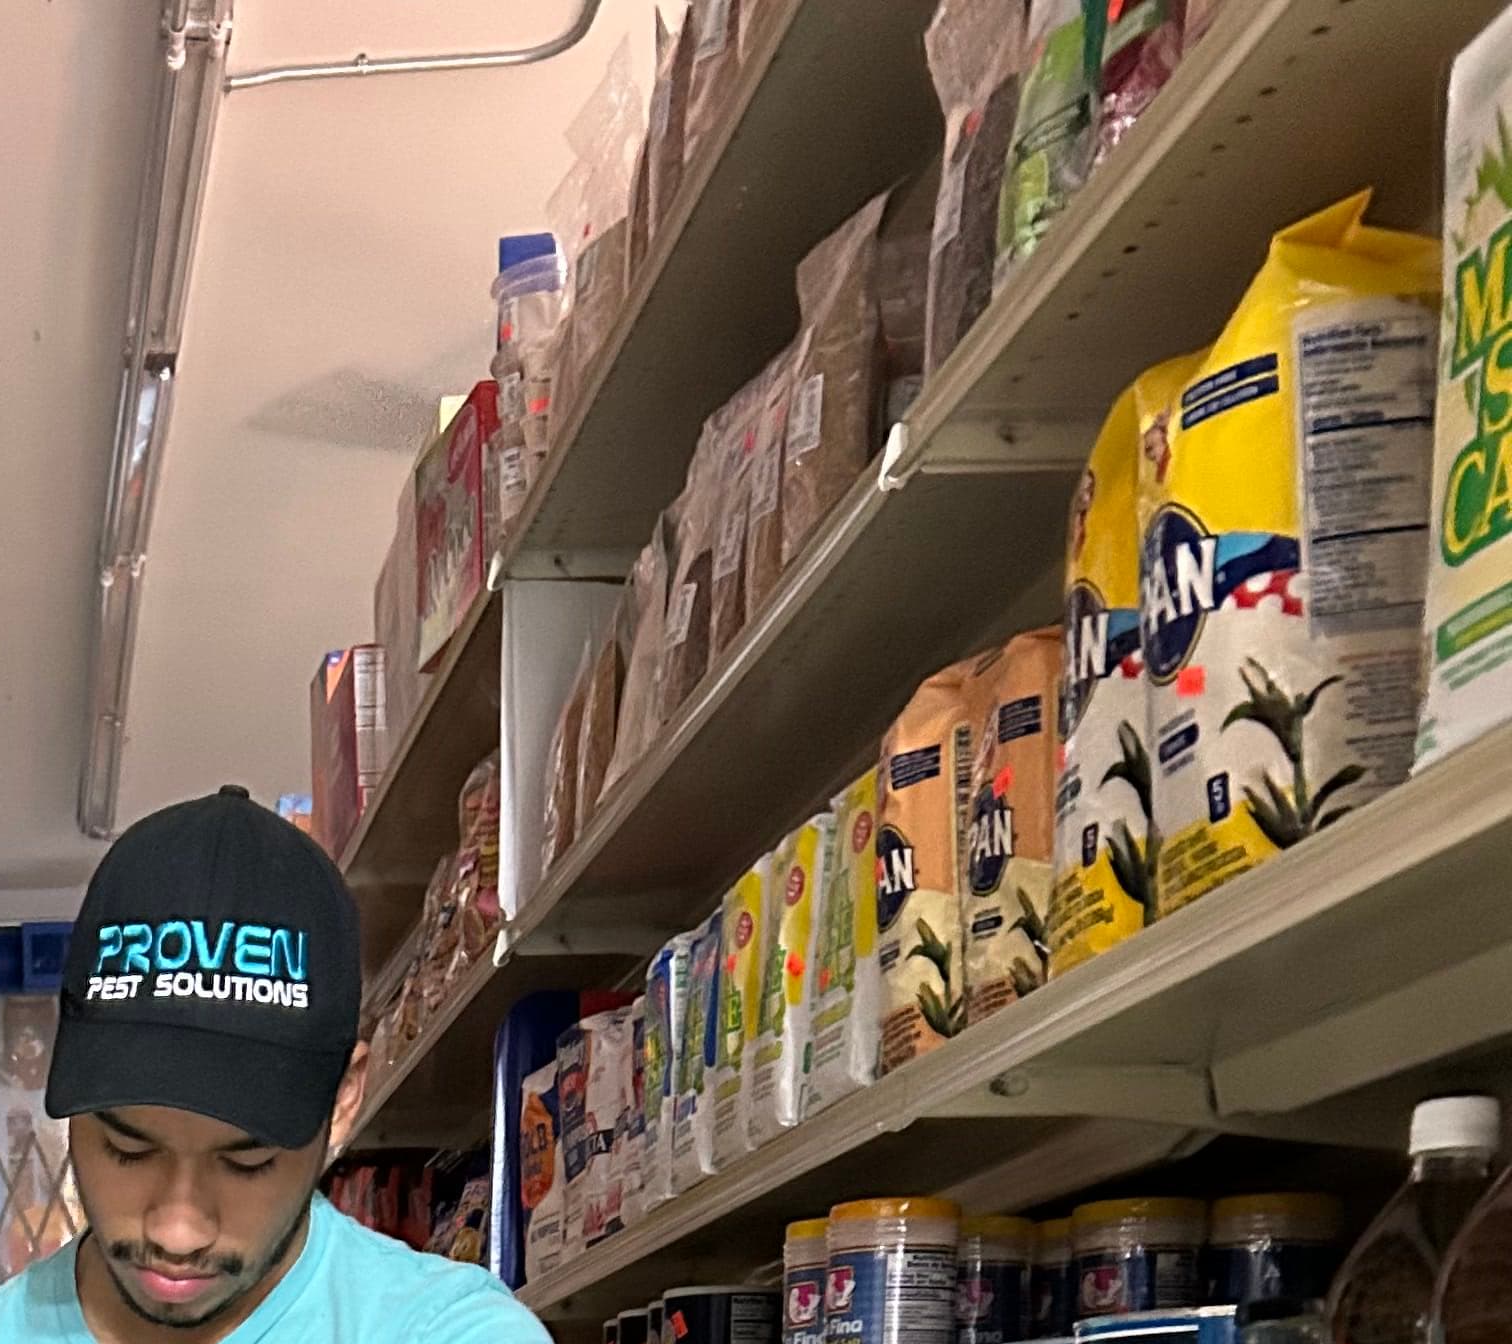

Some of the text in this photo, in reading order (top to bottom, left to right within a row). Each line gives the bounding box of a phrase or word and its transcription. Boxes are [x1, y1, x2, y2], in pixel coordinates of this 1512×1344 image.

[879, 849, 914, 894] AN
[96, 920, 309, 981] PROVEN
[86, 972, 309, 1008] PEST SOLUTIONS
[830, 1317, 864, 1333] Fina
